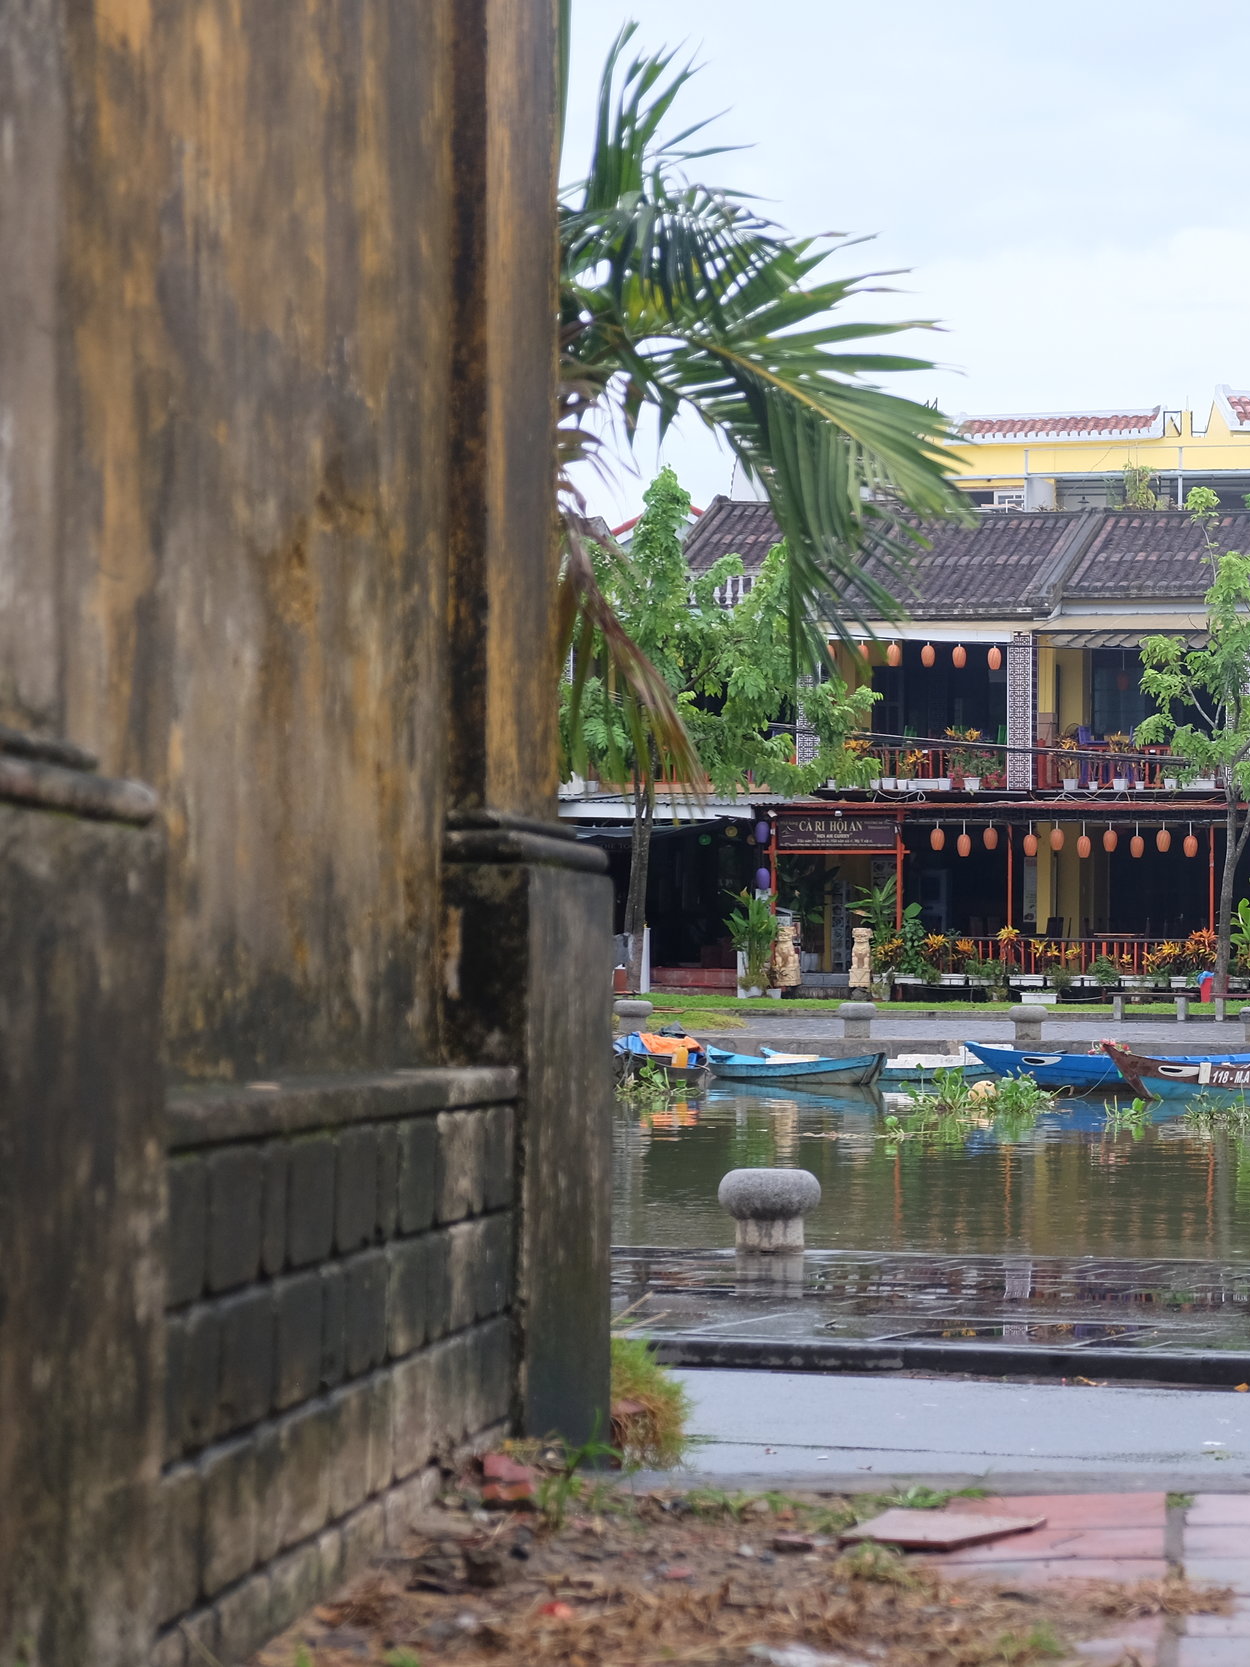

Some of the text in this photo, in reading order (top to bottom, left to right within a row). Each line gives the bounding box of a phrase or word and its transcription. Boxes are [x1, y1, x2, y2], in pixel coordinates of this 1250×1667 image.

[815, 820, 825, 832] RI
[830, 818, 848, 834] HỘI
[849, 820, 863, 832] AN
